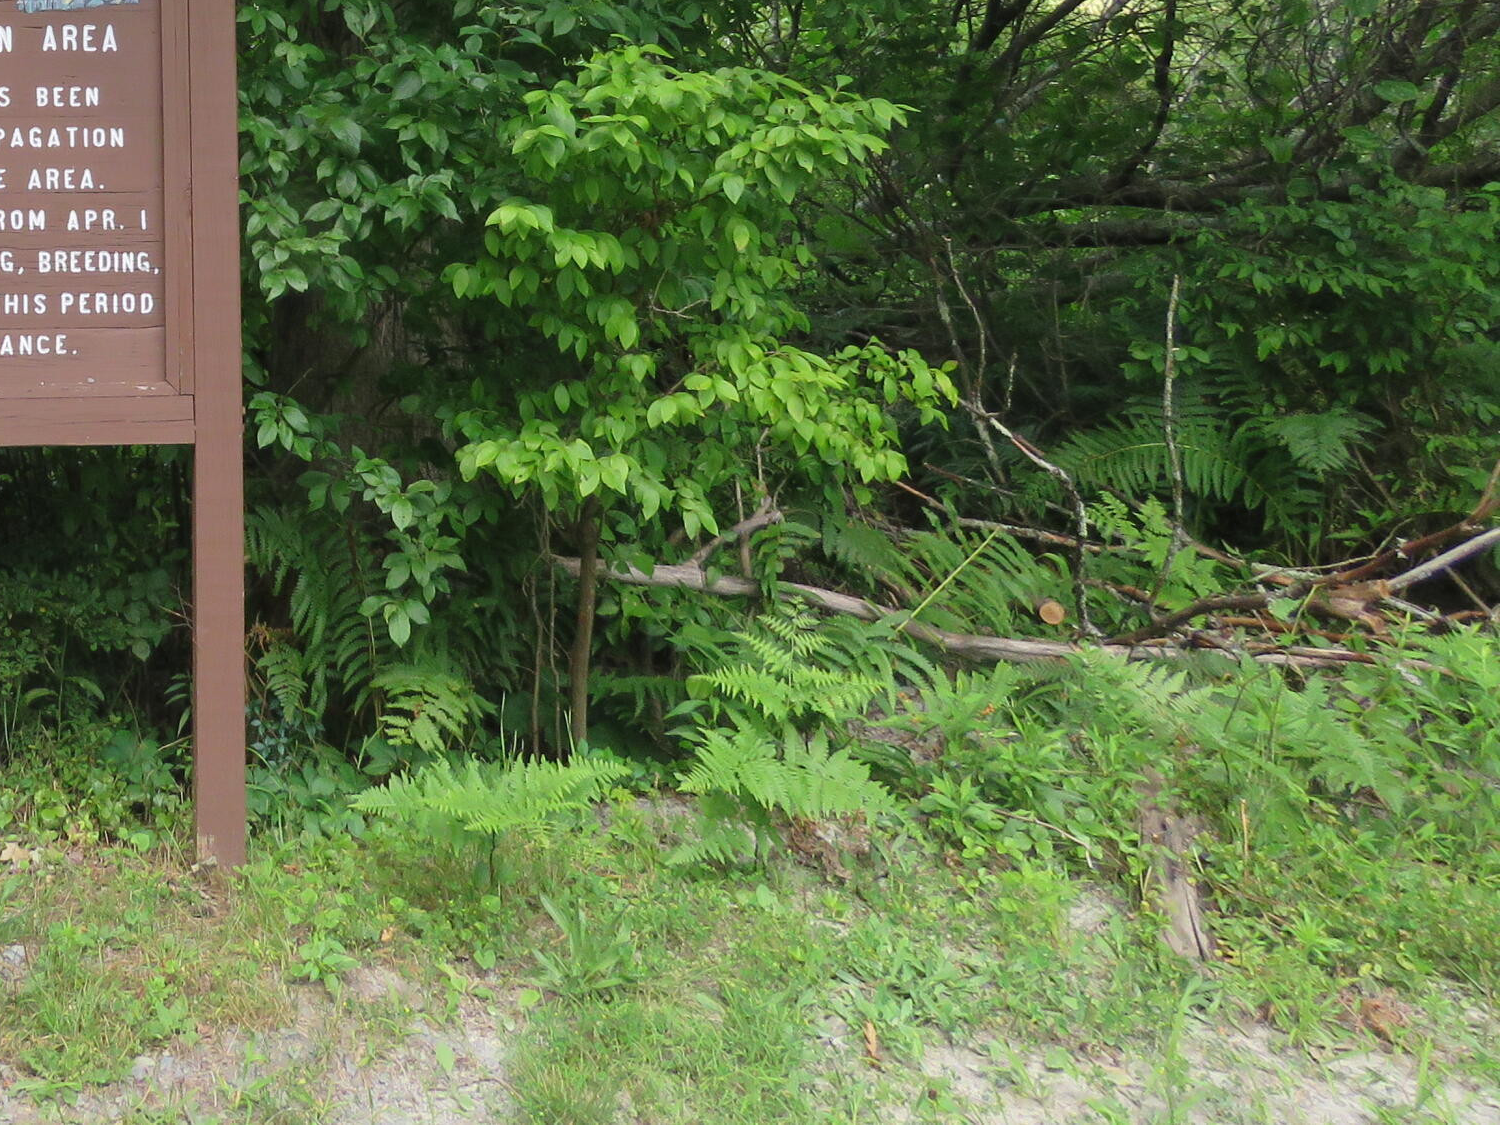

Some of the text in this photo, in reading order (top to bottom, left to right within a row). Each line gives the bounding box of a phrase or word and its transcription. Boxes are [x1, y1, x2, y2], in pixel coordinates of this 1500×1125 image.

[42, 23, 118, 53] AREA
[35, 85, 100, 108] BEEN
[27, 166, 105, 191] AREA.
[66, 208, 125, 232] APR.
[140, 209, 147, 231] 1
[38, 249, 160, 275] BREEDING,
[60, 292, 154, 315] PERIOD
